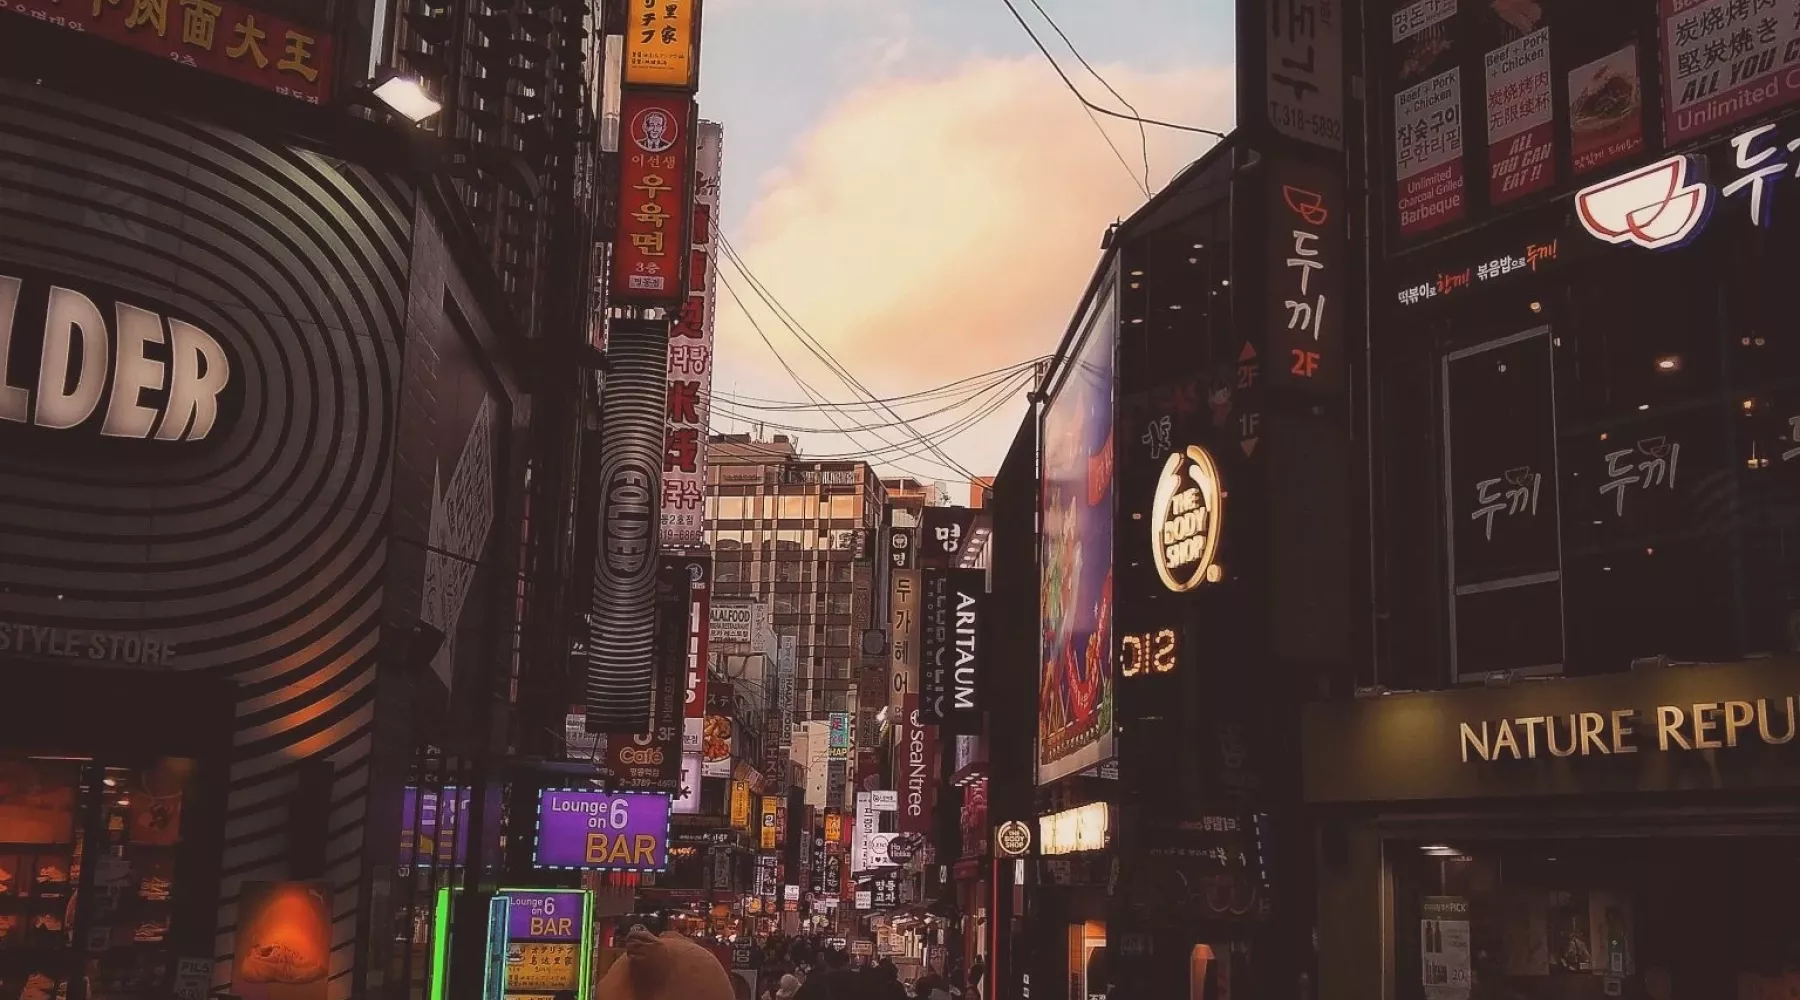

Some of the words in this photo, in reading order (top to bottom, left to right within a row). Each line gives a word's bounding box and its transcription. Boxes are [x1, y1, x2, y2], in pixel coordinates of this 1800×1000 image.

[1486, 48, 1509, 67] Beef
[1523, 31, 1548, 50] Pork
[1501, 47, 1544, 73] Chicken
[1399, 86, 1421, 106] Beef
[1433, 72, 1456, 90] Pork
[1680, 69, 1721, 105] ALL
[1730, 46, 1778, 86] YOU
[1413, 88, 1452, 112] Chicken
[1677, 75, 1779, 131] Unlimited
[1397, 103, 1459, 148] 참숯구이
[1398, 125, 1461, 169] 무한리필
[1492, 155, 1519, 178] YOU
[1522, 141, 1552, 164] CAN
[1508, 132, 1533, 156] ALL
[632, 154, 675, 168] 이선생
[1398, 188, 1434, 210] Charcoal
[1436, 175, 1463, 195] Grilled
[1407, 166, 1452, 194] Unlimited
[1502, 171, 1528, 192] EAT
[629, 173, 672, 256] 우육면
[1401, 194, 1460, 226] Barbeque
[1476, 254, 1527, 282] 볶음밥으로
[1525, 237, 1557, 272] 두끼!
[1284, 229, 1326, 342] 두끼
[668, 344, 707, 374] 라탕
[1290, 348, 1320, 378] 2F
[1237, 364, 1259, 390] 2F
[1239, 412, 1260, 437] 1F
[661, 478, 702, 509] 국수
[1598, 443, 1681, 517] 두끼
[1172, 487, 1200, 515] THE
[1471, 472, 1541, 541] 두끼
[607, 468, 649, 573] FOLDER
[1164, 506, 1206, 545] BODY
[1166, 535, 1206, 569] SHOP
[955, 591, 976, 709] ARITAUM
[1459, 709, 1638, 763] NATURE
[1656, 696, 1796, 752] REPU
[619, 746, 664, 765] Café
[908, 730, 927, 816] seaNtree
[552, 797, 608, 816] Lounge
[588, 815, 607, 828] on
[610, 799, 628, 829] 6
[586, 832, 657, 865] BAR
[1005, 841, 1024, 849] SHOP
[510, 897, 543, 908] Lounge
[544, 897, 555, 915] 6
[530, 917, 572, 936] BAR
